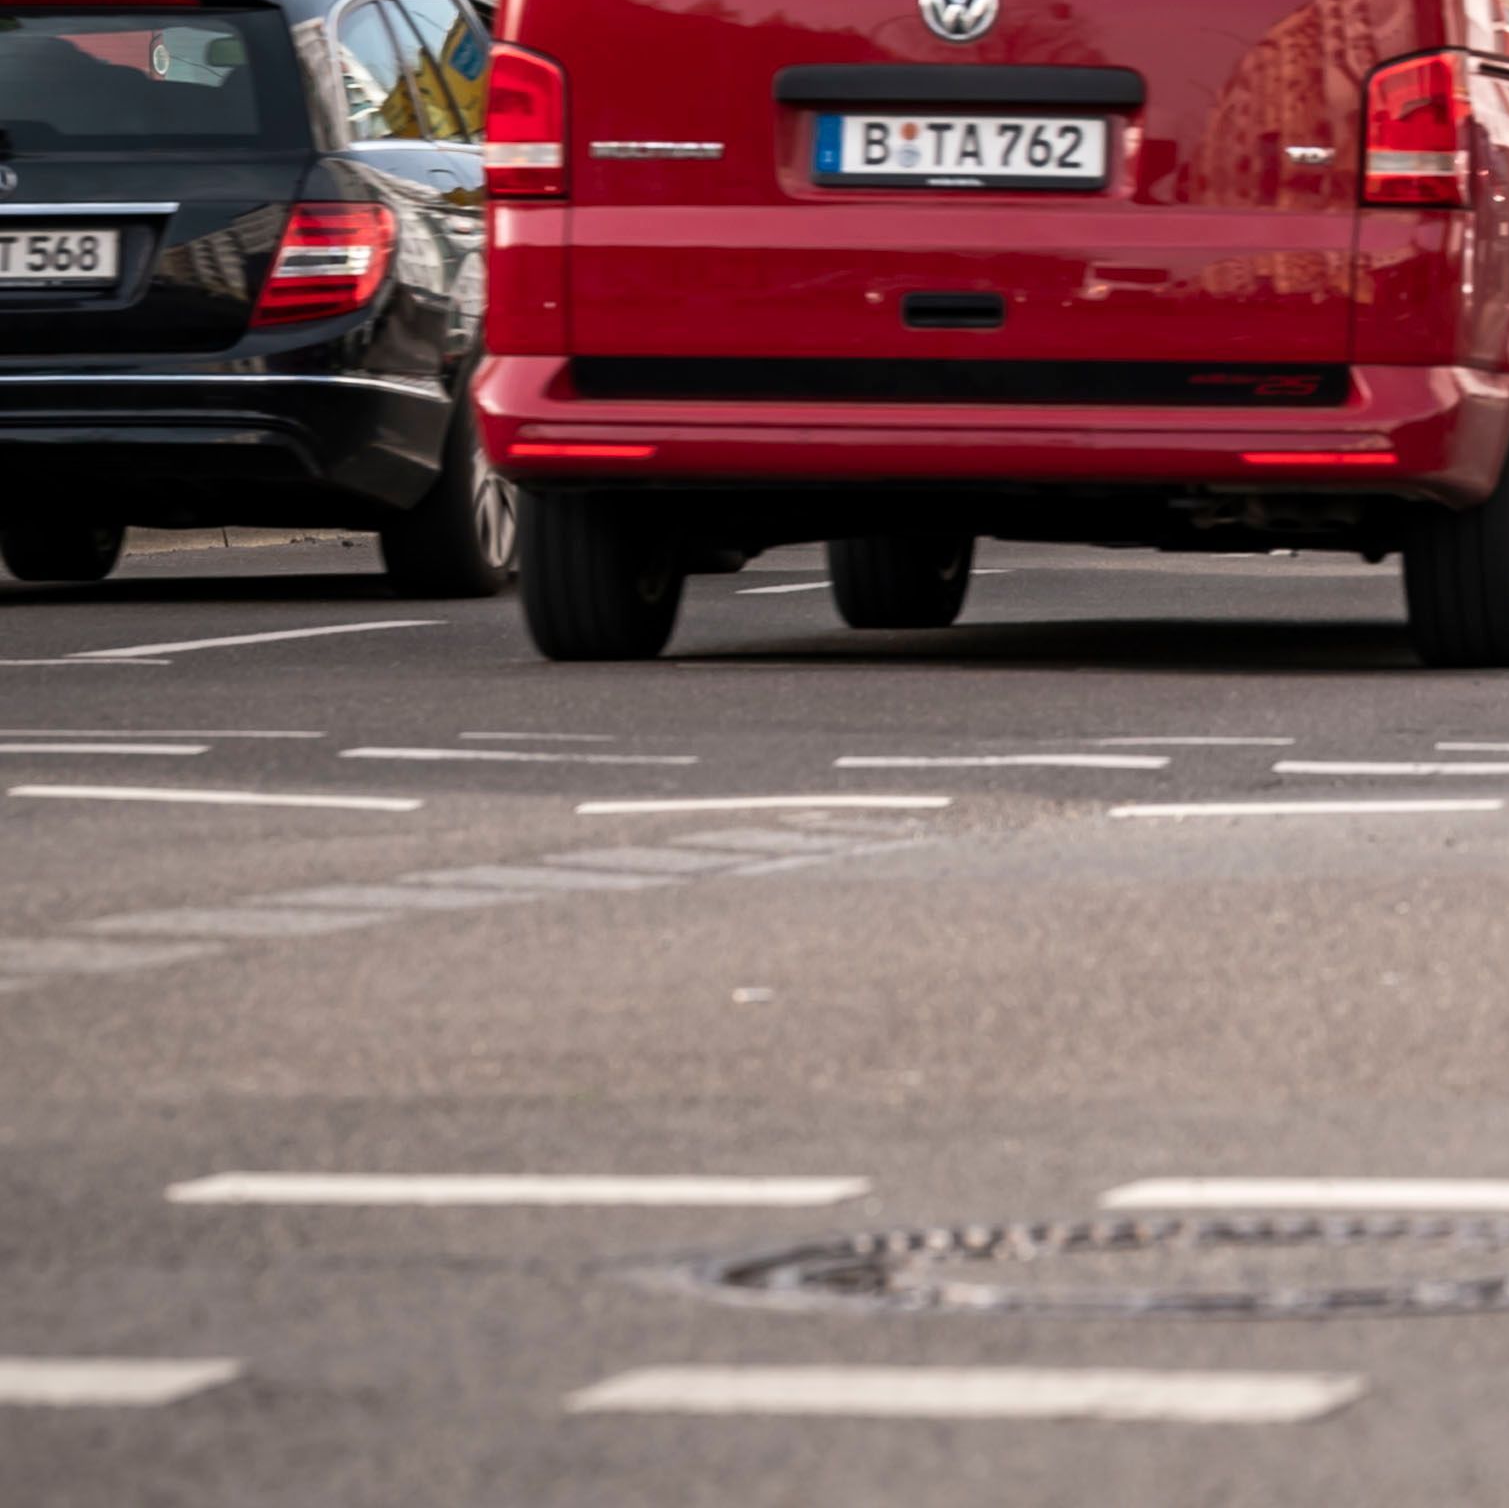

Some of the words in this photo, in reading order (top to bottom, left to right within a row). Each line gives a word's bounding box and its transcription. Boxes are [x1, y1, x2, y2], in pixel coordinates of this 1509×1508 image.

[863, 122, 890, 165] B
[925, 122, 984, 167] TA
[996, 123, 1083, 169] 762
[26, 235, 100, 272] 568
